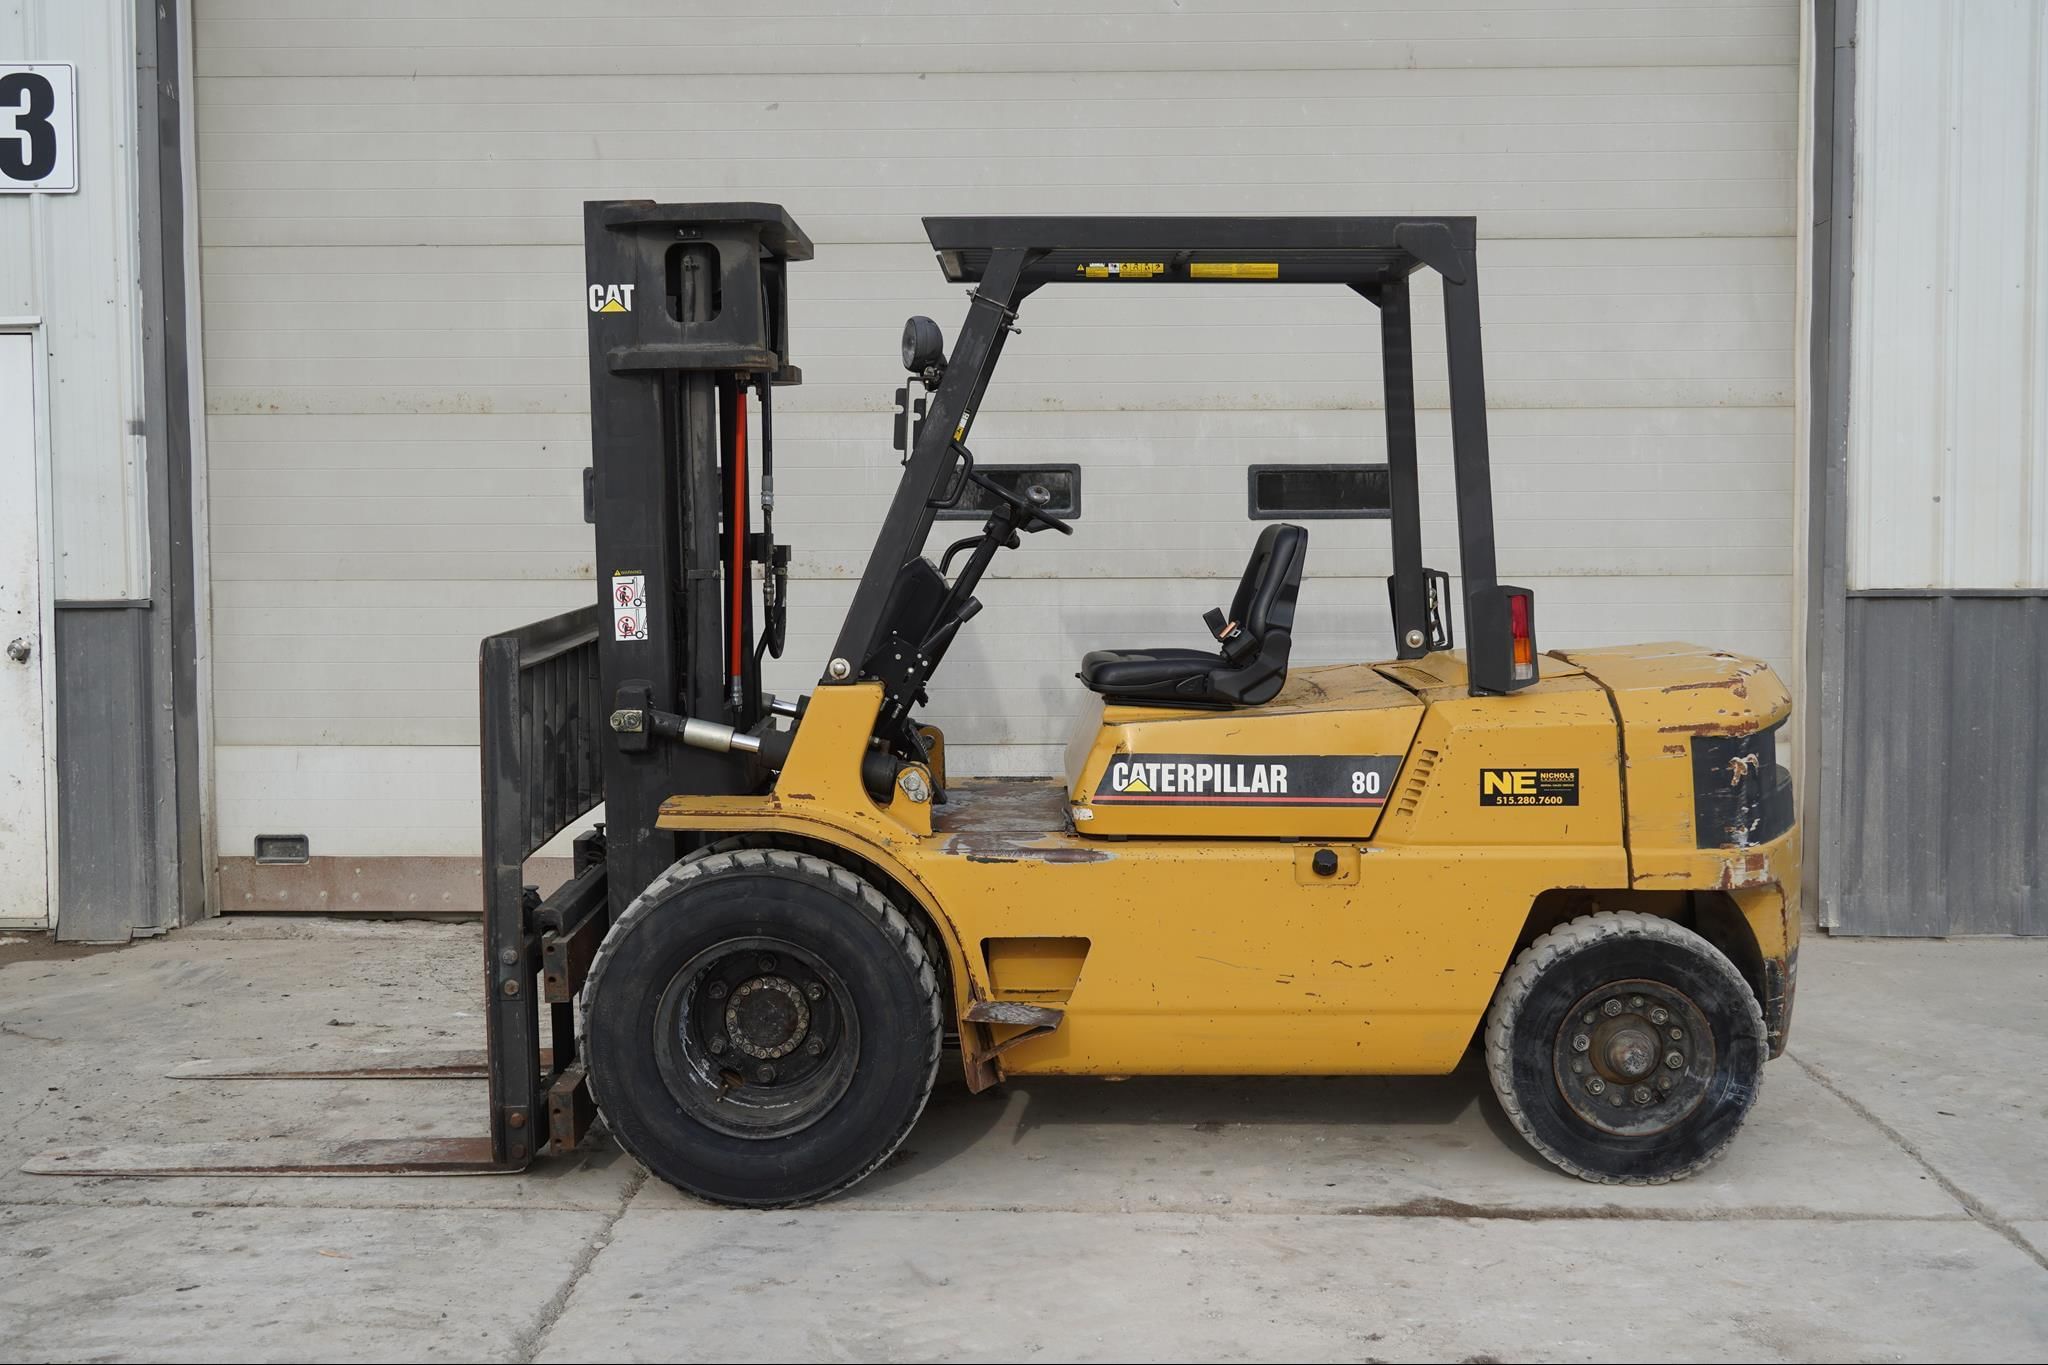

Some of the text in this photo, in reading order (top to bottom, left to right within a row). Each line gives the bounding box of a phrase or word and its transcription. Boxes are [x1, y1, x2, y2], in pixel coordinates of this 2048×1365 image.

[0, 72, 57, 181] 3
[589, 284, 635, 312] CAT
[1112, 762, 1380, 794] CATERPILLAR 80
[1484, 771, 1537, 795] NE
[1496, 796, 1563, 805] 515.280.7600
